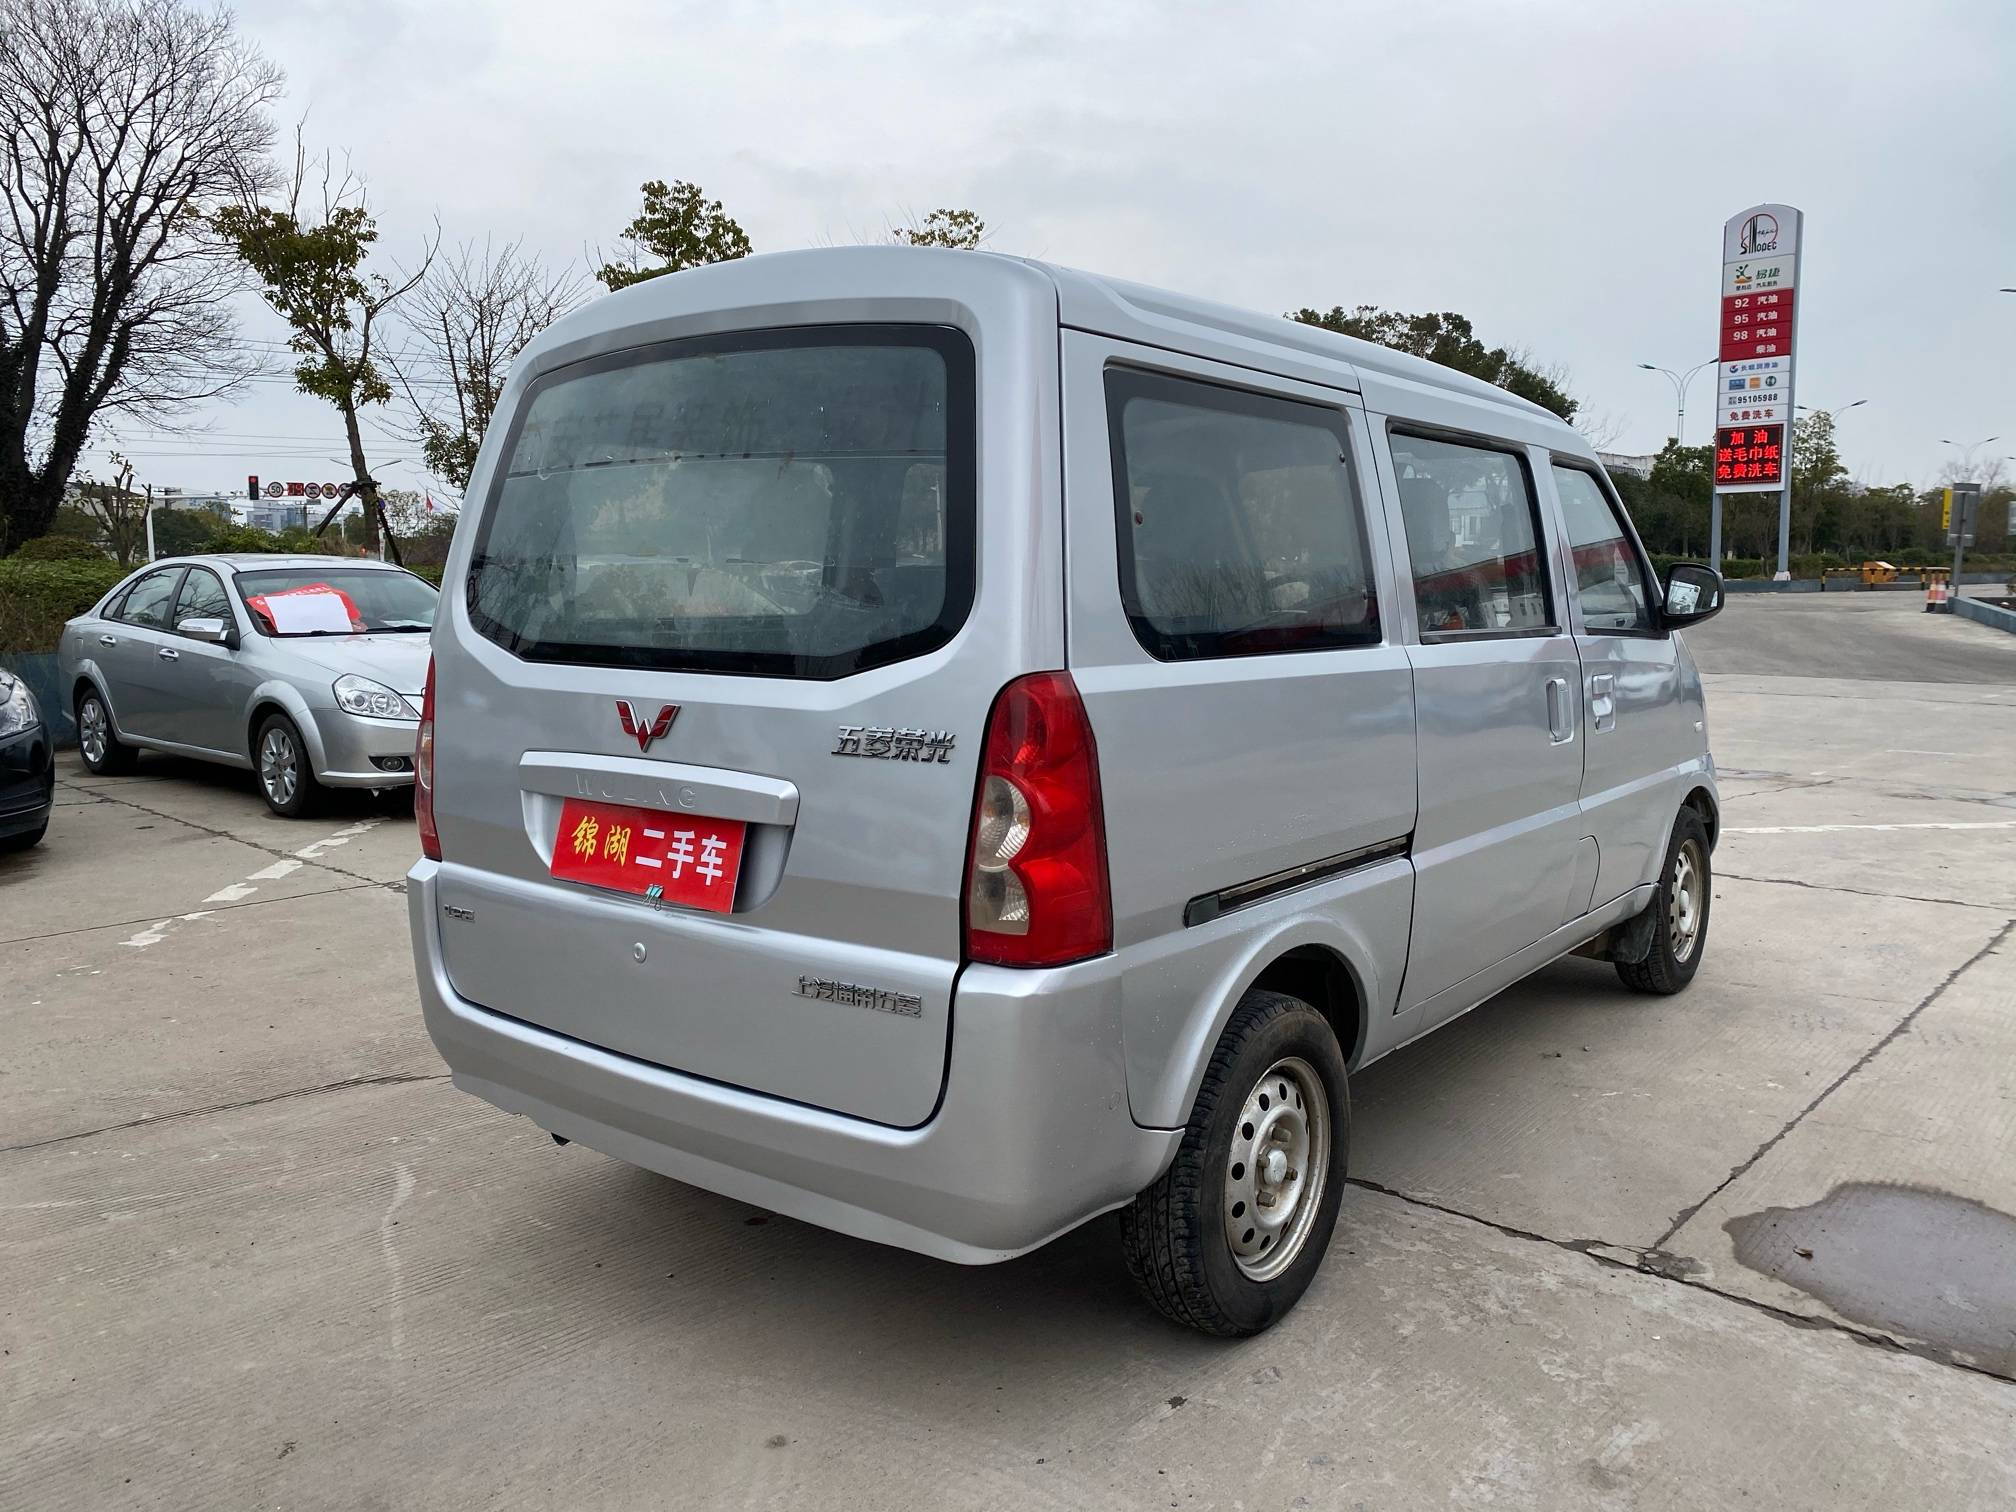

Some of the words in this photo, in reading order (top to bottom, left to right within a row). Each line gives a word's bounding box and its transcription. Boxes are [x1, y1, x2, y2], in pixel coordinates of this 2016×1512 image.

[1739, 236, 1777, 255] SINOPEC
[1734, 298, 1749, 308] 92
[1757, 294, 1778, 305] 汽油
[1734, 314, 1749, 324] 95
[1757, 310, 1778, 321] 汽油
[1733, 330, 1748, 340] 98
[1756, 327, 1777, 338] 汽油
[1737, 393, 1778, 404] 95105988
[1730, 408, 1774, 421] 免费洗车
[1719, 445, 1779, 462] 送毛巾纸
[1717, 461, 1778, 479] 免费洗车
[831, 725, 956, 764] 五菱荣光
